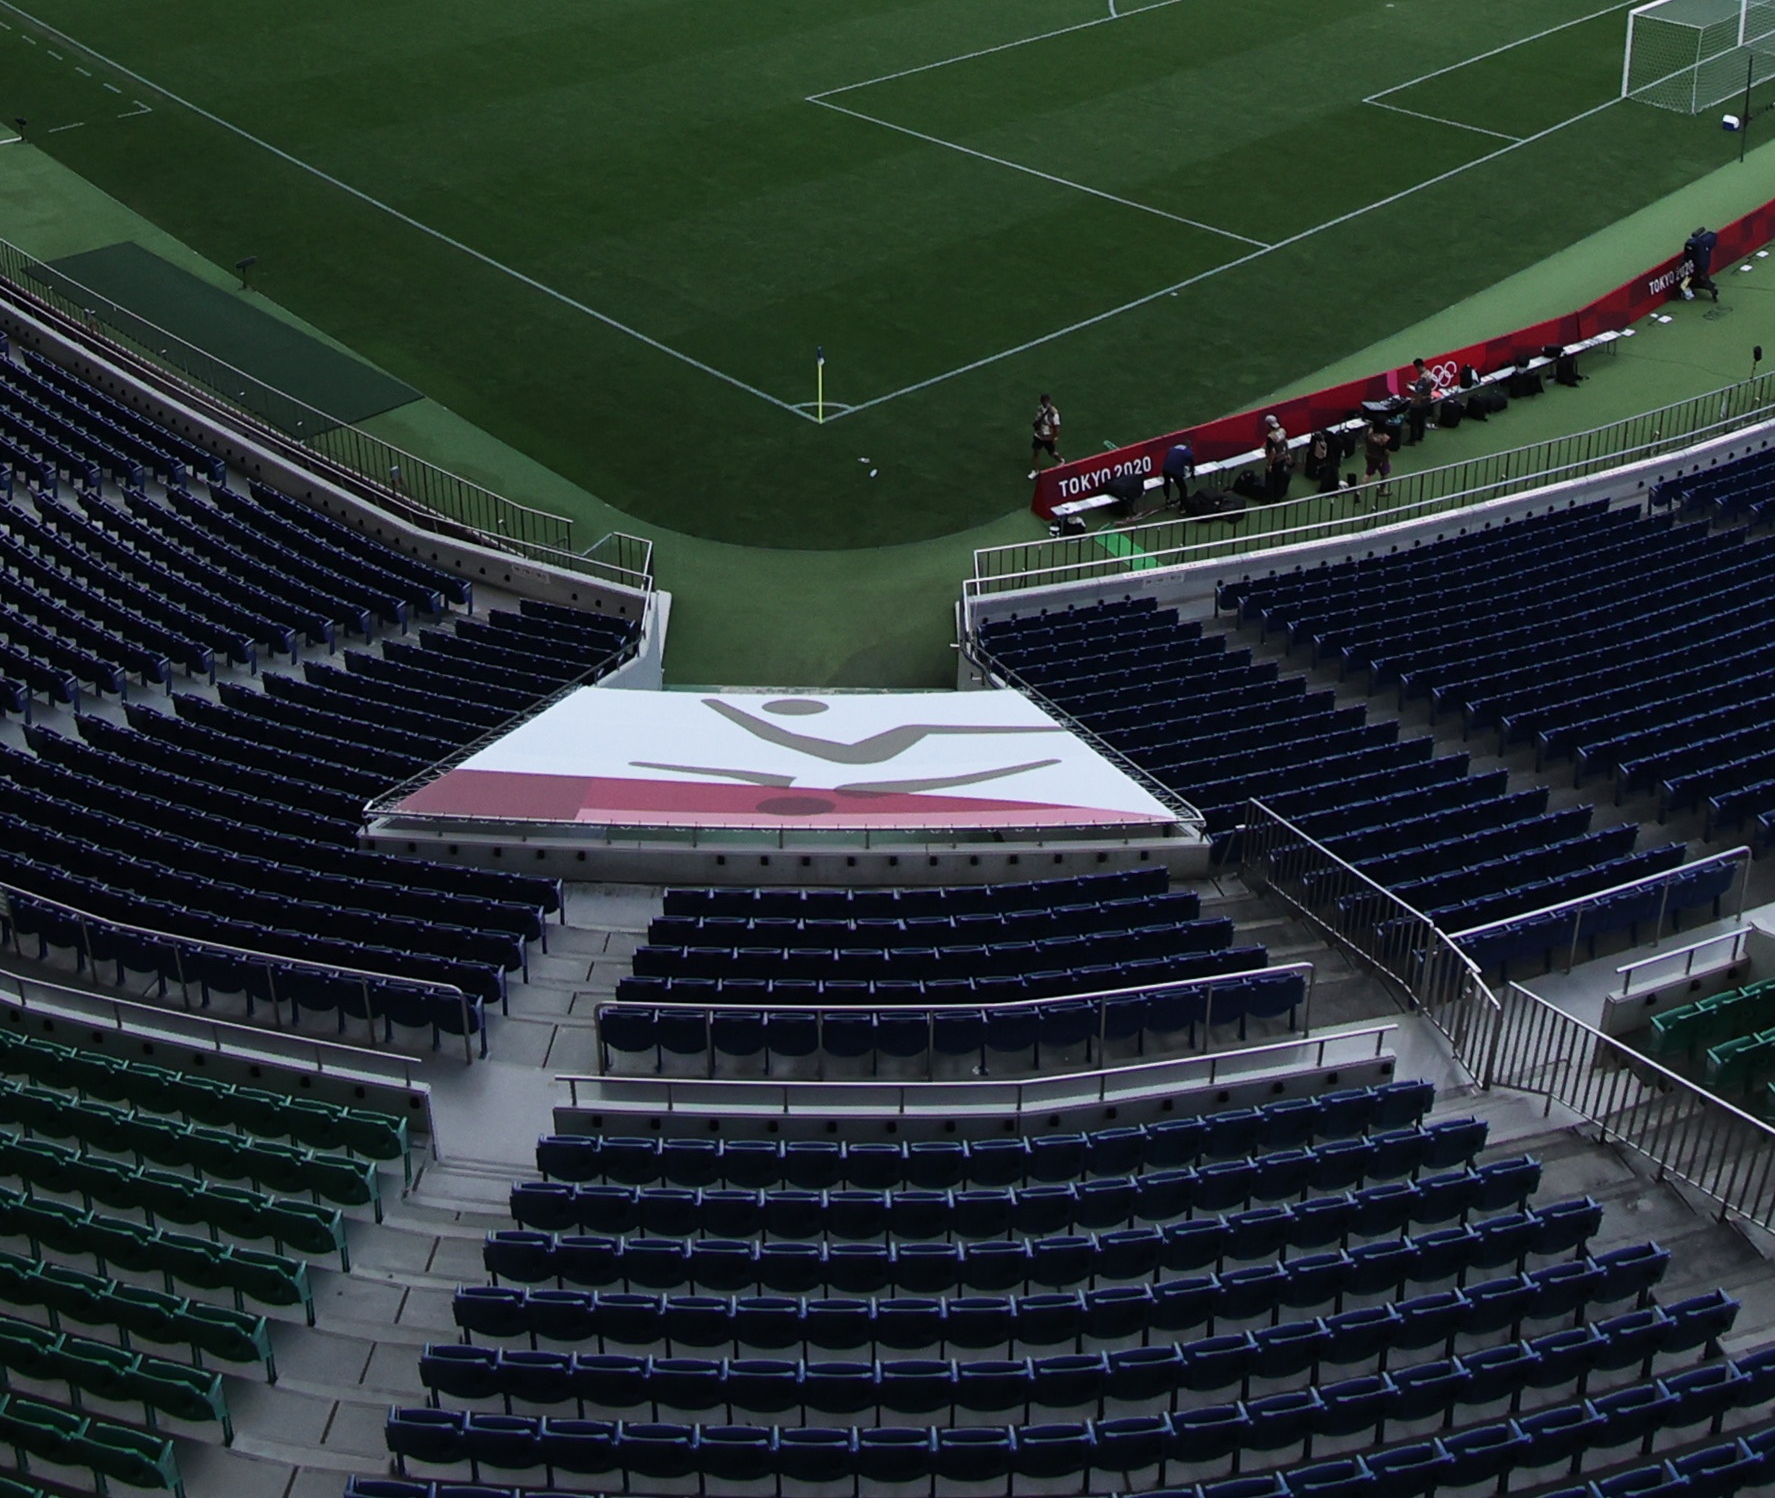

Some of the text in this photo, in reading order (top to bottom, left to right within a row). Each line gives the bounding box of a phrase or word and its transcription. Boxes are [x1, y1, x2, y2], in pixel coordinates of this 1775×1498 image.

[1648, 270, 1675, 295] TOKYO
[1059, 455, 1152, 497] TOKYO 2020
